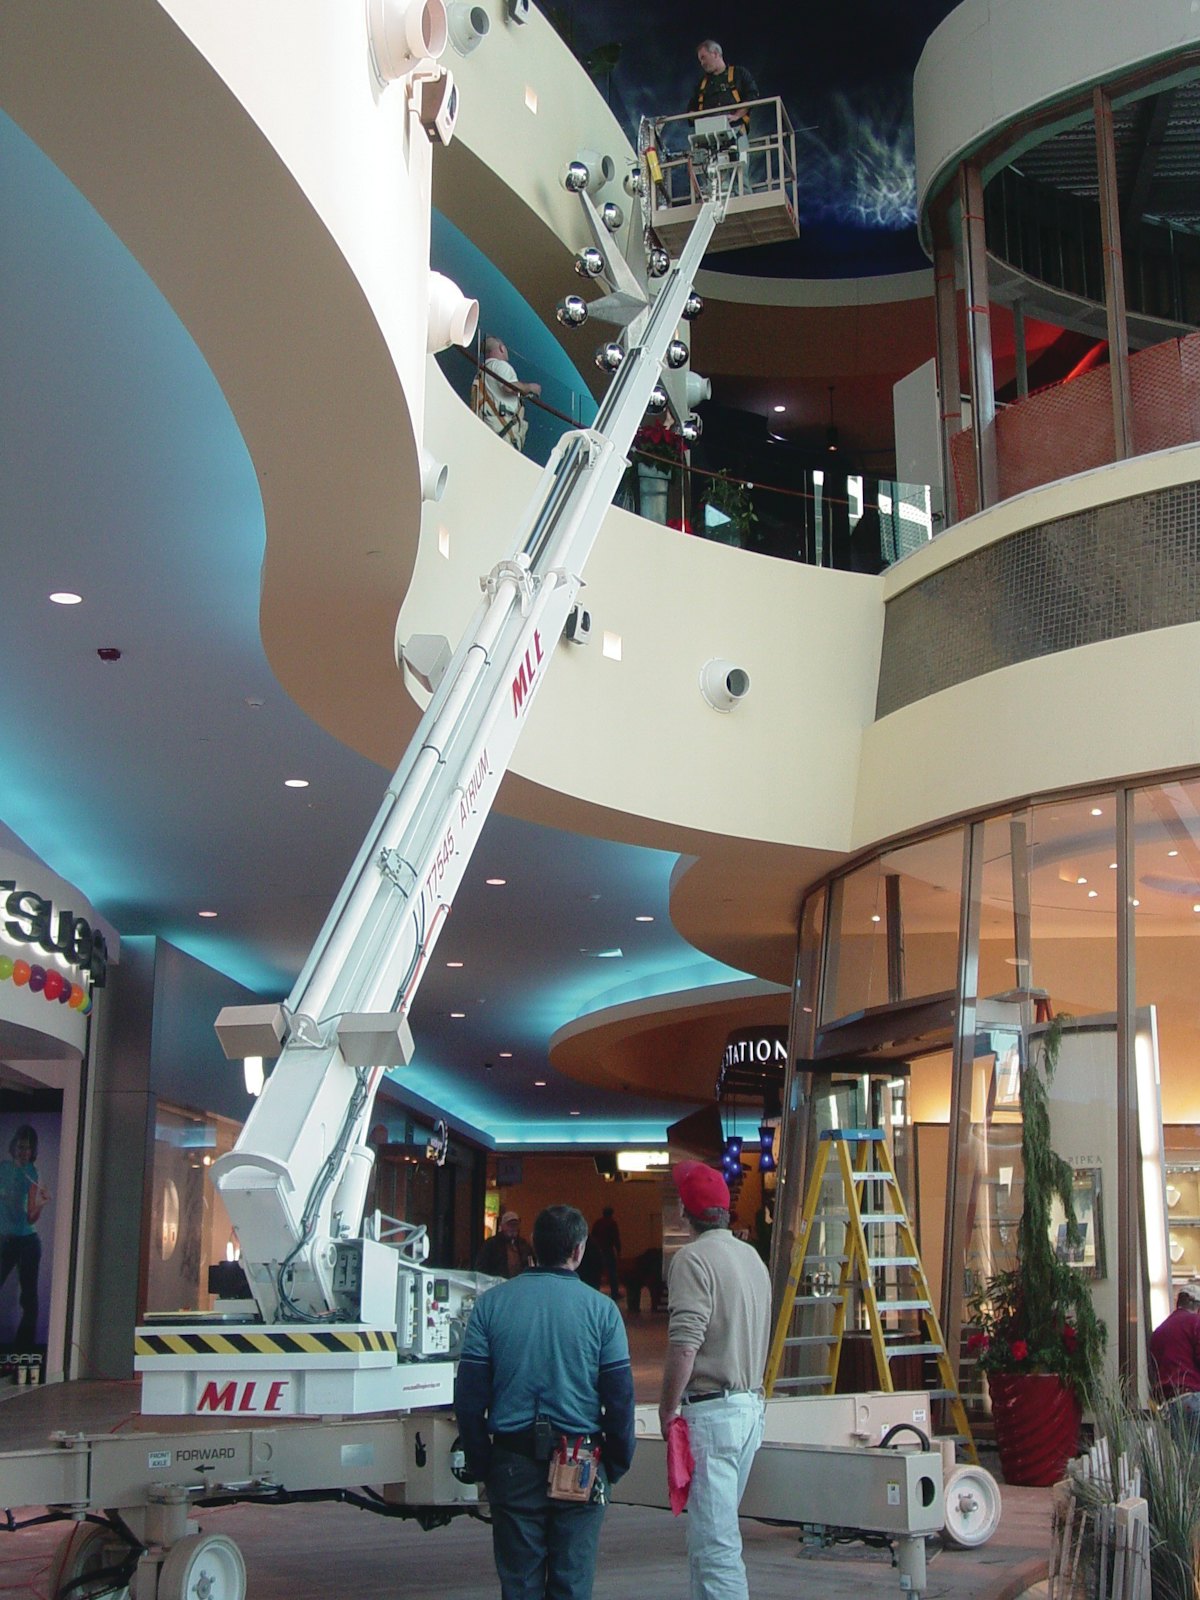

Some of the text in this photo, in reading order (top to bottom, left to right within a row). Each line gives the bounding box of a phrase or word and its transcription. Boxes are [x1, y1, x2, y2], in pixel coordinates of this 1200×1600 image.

[459, 746, 490, 829] ATRIUM
[196, 1381, 289, 1411] MLE
[176, 1447, 235, 1462] FORWARD
